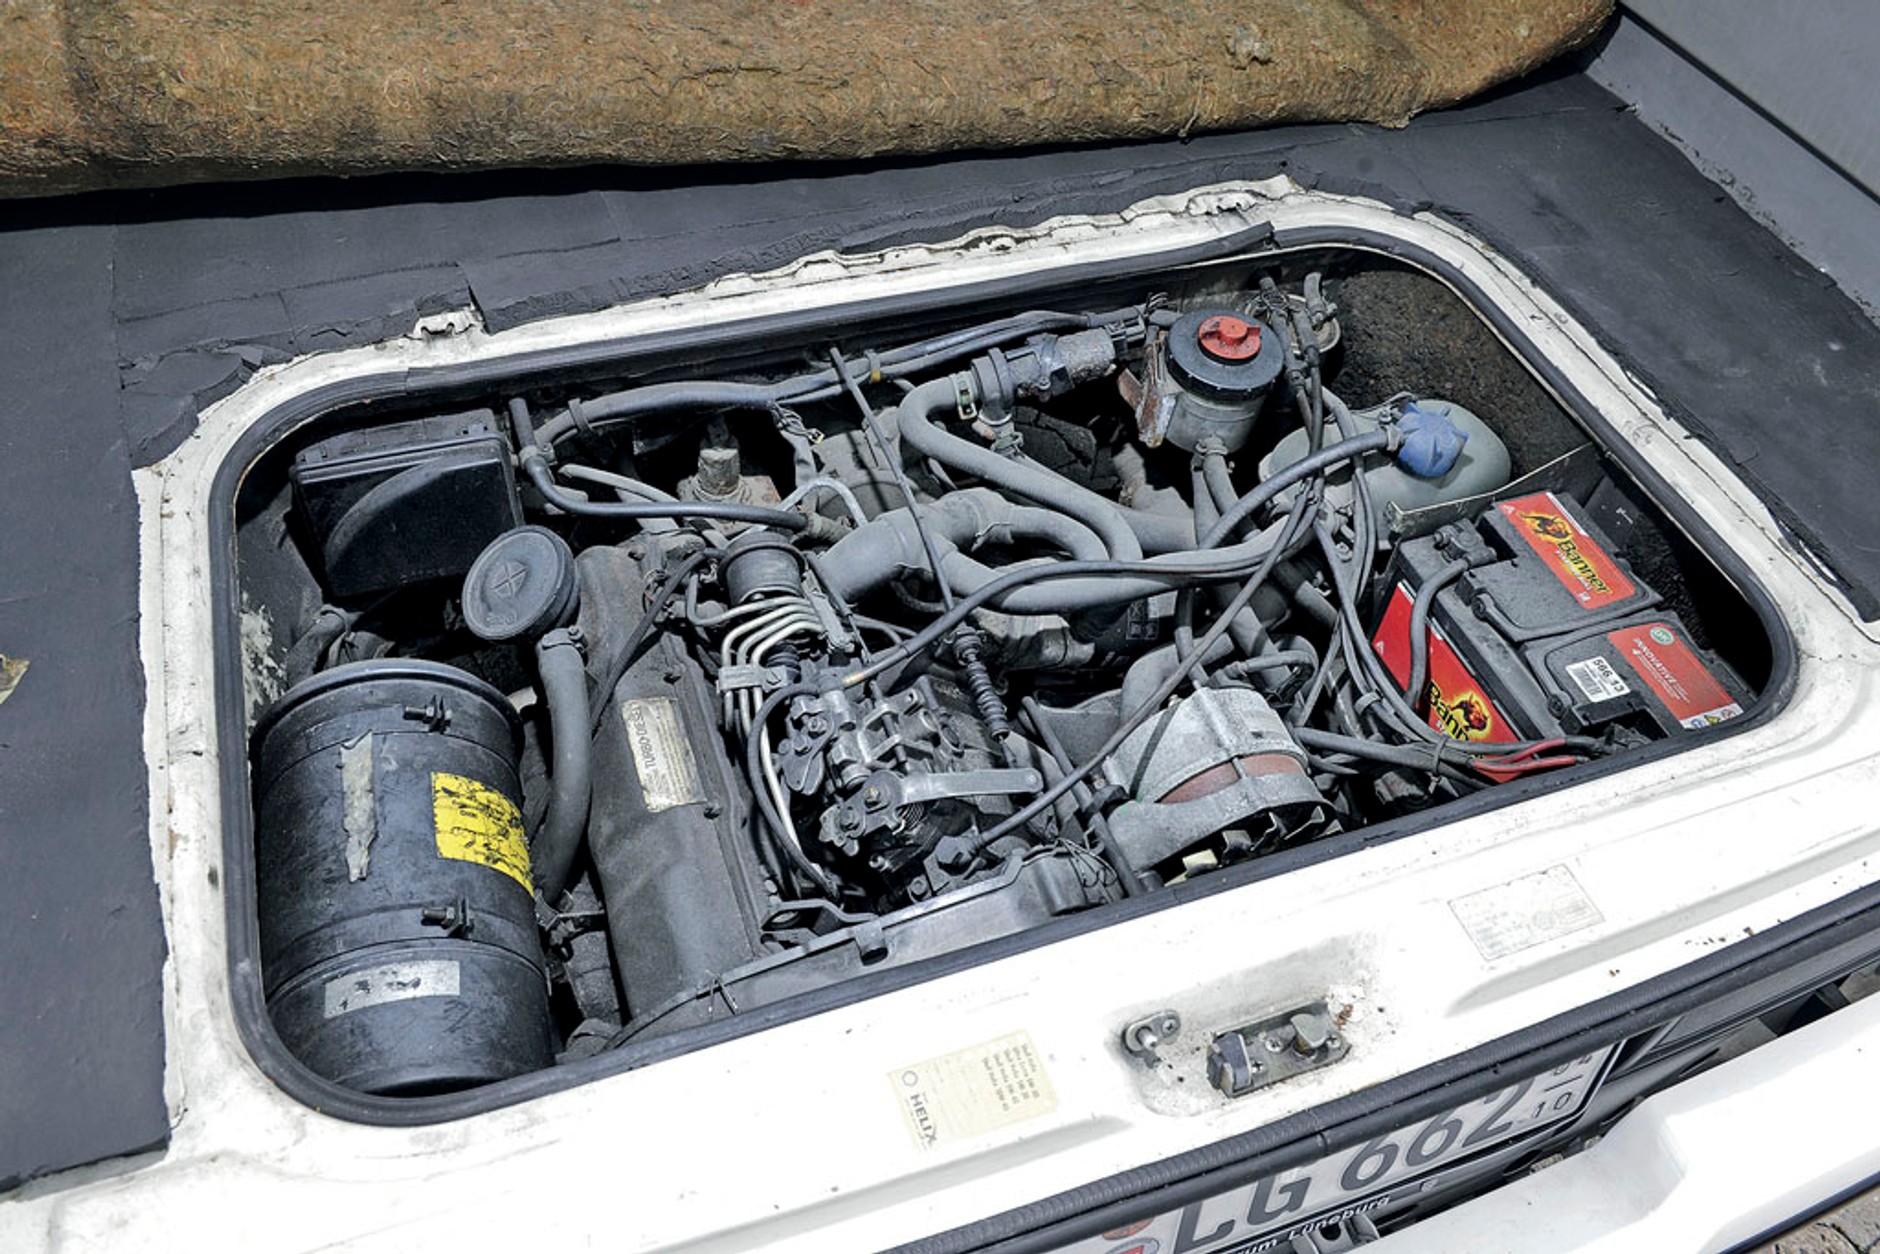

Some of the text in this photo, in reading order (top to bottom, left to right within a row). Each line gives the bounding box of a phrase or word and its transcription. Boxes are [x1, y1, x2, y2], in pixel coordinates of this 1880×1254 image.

[1557, 539, 1612, 594] Banner
[1633, 637, 1678, 685] INNOVATIVE
[1424, 679, 1476, 748] Bann
[910, 1093, 938, 1148] HELIX
[1532, 1092, 1573, 1119] 10
[1340, 1077, 1536, 1191] 662
